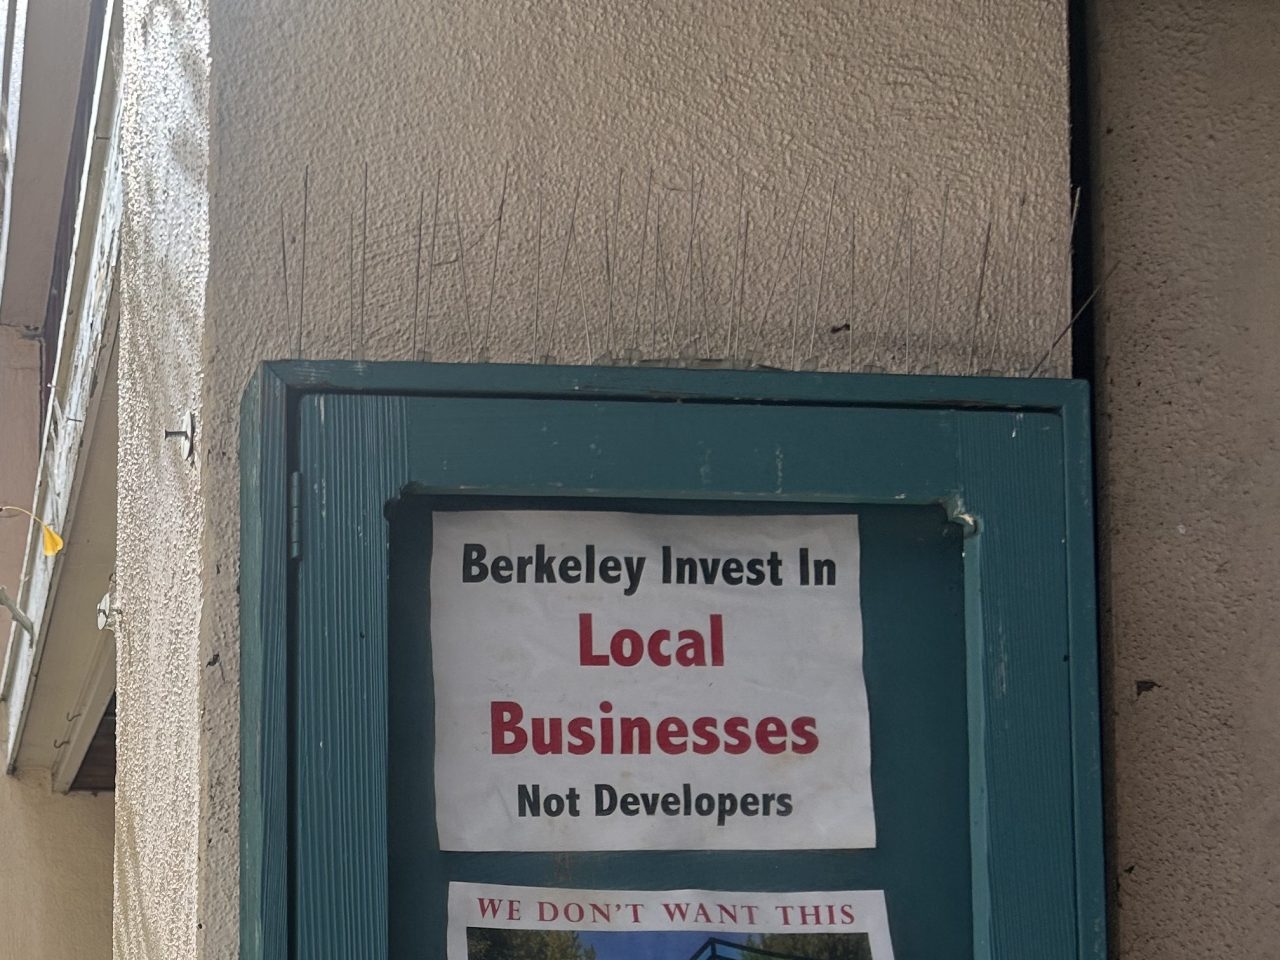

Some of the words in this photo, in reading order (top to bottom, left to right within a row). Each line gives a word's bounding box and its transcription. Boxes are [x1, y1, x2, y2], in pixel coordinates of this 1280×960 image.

[462, 543, 646, 596] Berkeley
[661, 546, 783, 586] Invest
[799, 547, 837, 586] In
[579, 613, 725, 667] Local
[490, 701, 819, 755] Businesses
[518, 784, 580, 818] Not
[594, 783, 793, 826] Developers
[477, 897, 521, 921] WE
[537, 900, 644, 924] DON'T
[662, 903, 759, 925] WANT
[776, 904, 856, 926] THIS
